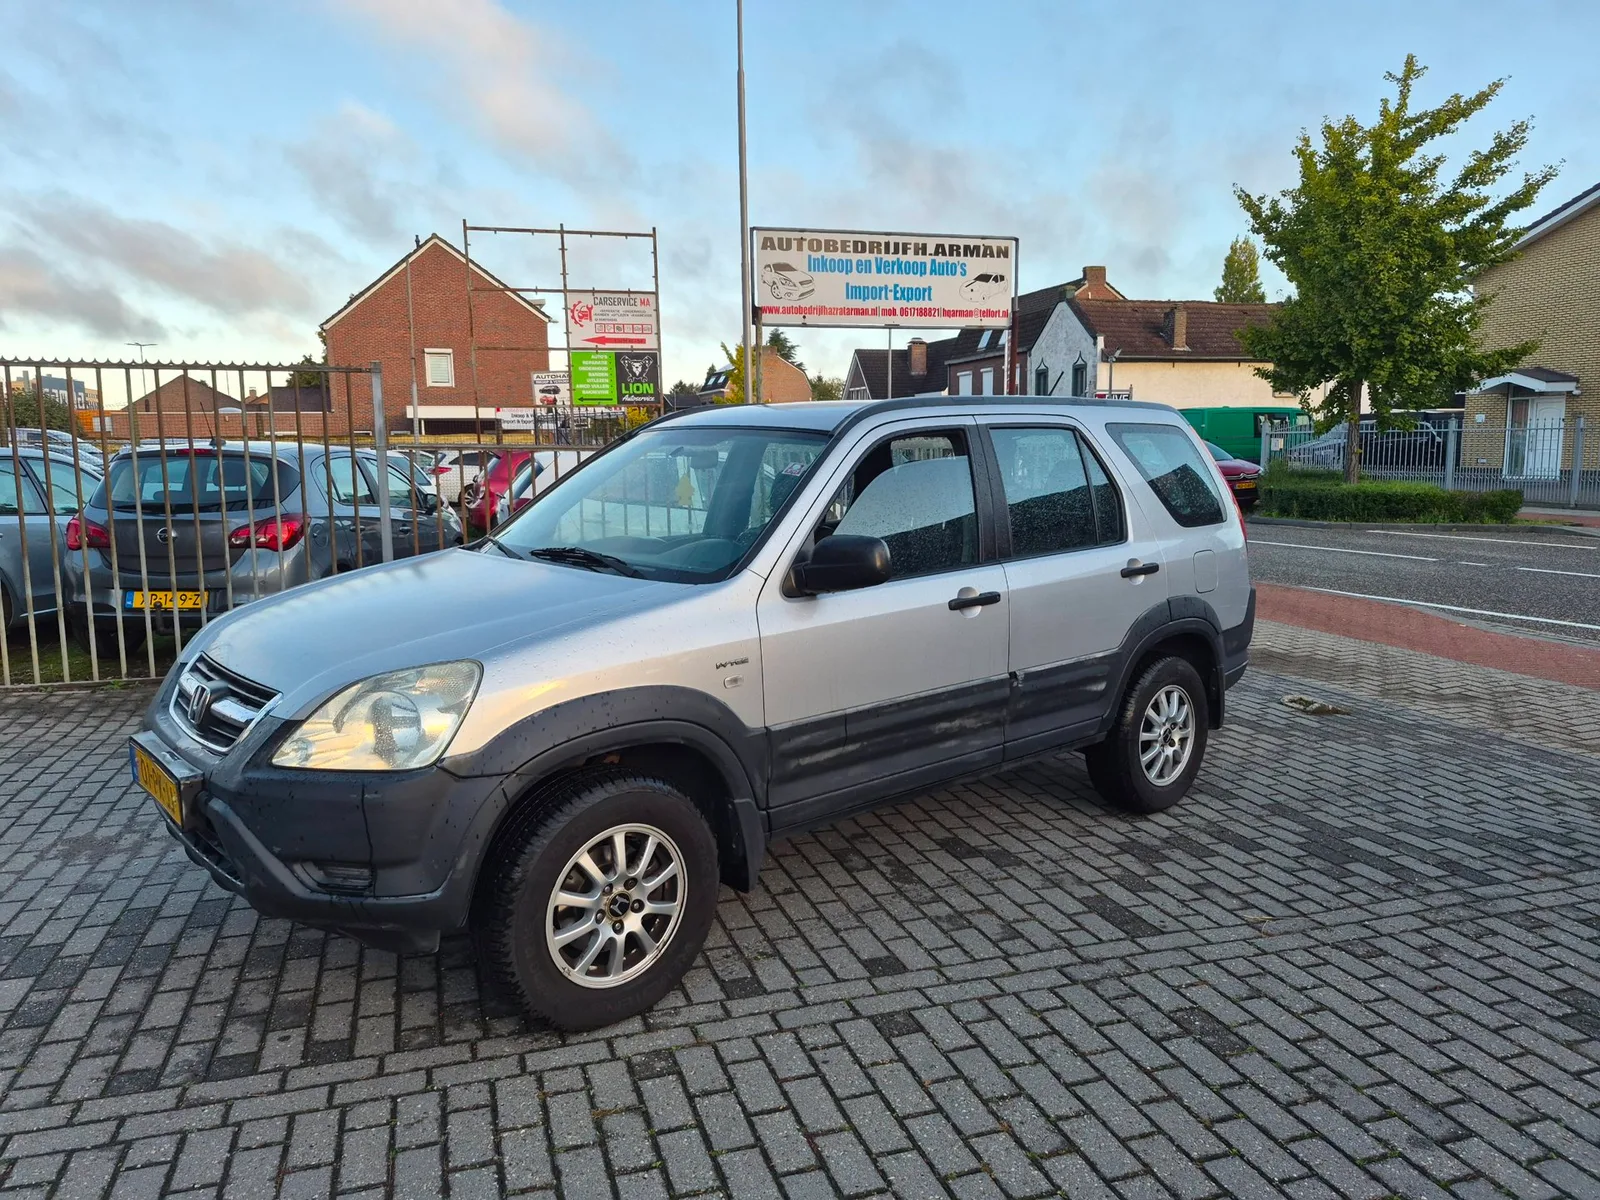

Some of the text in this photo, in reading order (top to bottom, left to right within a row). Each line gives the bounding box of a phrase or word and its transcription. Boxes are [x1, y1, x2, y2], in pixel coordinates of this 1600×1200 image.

[808, 255, 967, 277] Inkoop en Verkoop Auto's
[845, 282, 932, 302] Import-Export
[593, 296, 651, 307] CARSERVICE MA
[881, 307, 899, 317] mob.
[621, 383, 654, 394] LION
